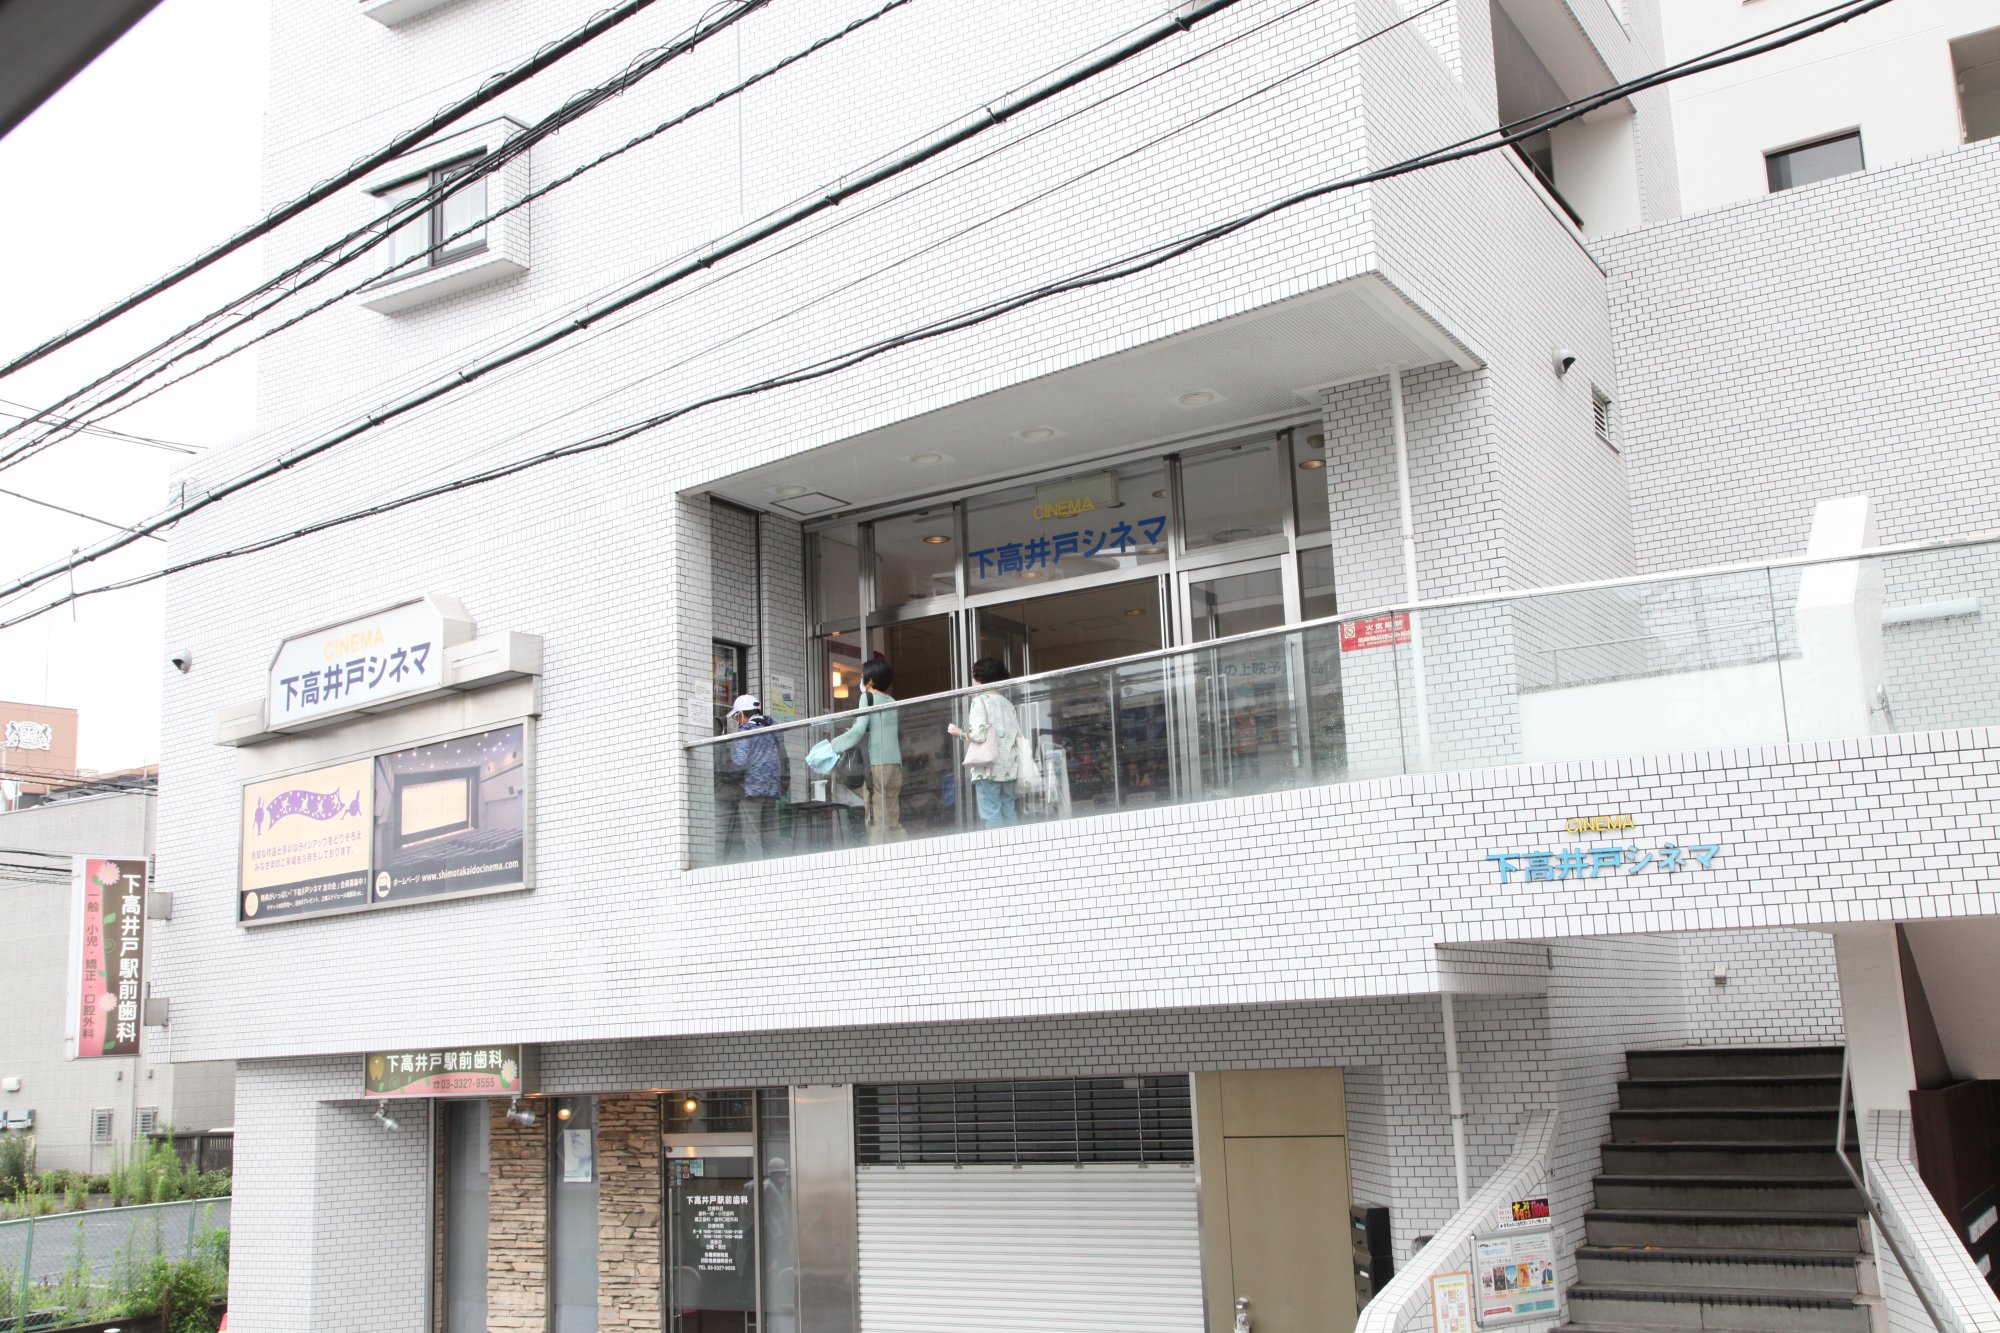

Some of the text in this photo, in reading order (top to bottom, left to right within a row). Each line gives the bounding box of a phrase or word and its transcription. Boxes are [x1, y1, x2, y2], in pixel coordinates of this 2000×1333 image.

[1032, 496, 1096, 521] CINEMA
[968, 516, 1167, 579] 下高井戸シネマ
[323, 626, 384, 661] CINEMA
[280, 642, 431, 711] 下高井戸シネマ
[1565, 814, 1635, 834] CINEMA
[393, 860, 519, 887] ホームページ www.shimotakaidocinema.com
[1486, 842, 1720, 884] 下高井戸シネマ
[116, 874, 141, 1043] 下高井戸駅前歯科
[386, 1049, 502, 1073] 下高井戸駅前歯科
[441, 1077, 495, 1089] 03-3327-9555
[686, 1195, 748, 1205] 下高井戸駅前歯科
